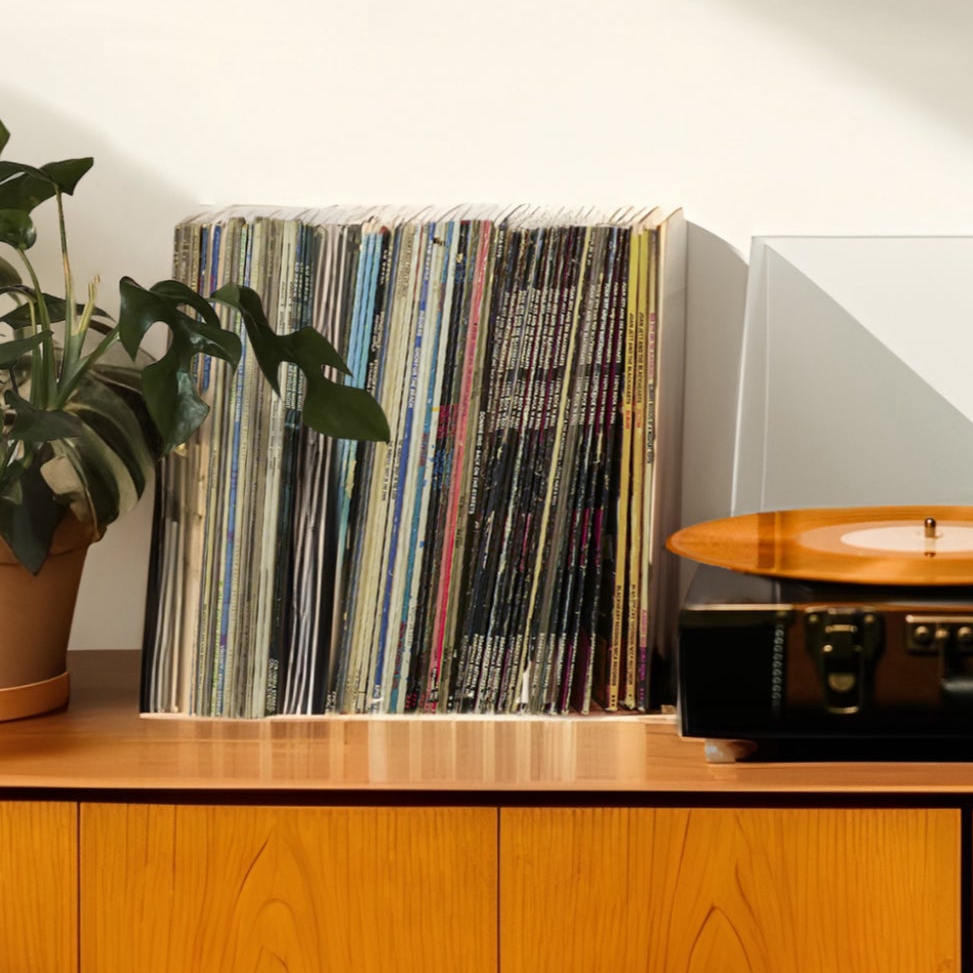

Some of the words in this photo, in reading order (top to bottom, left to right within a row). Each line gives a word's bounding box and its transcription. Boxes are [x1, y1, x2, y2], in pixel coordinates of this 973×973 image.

[476, 411, 486, 433] DONNIE
[475, 435, 483, 445] IRIS
[473, 450, 482, 465] BACK
[473, 467, 480, 475] ON
[468, 489, 478, 514] STREETS
